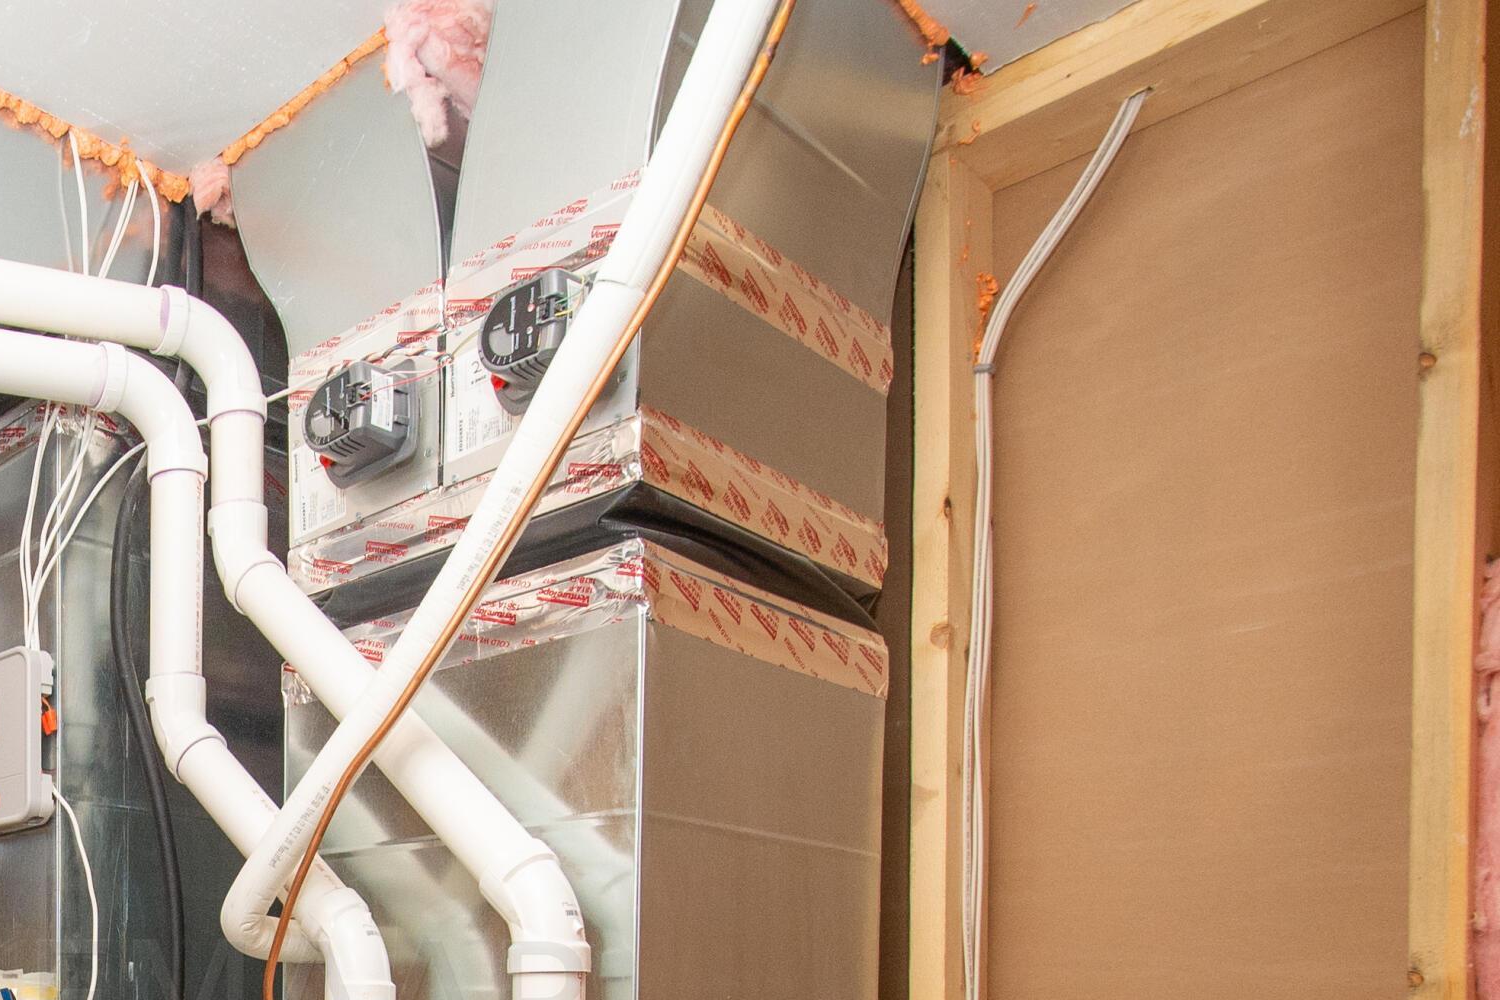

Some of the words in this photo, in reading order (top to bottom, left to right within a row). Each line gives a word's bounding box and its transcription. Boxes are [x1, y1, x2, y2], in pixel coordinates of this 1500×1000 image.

[567, 466, 622, 478] VentureTape
[365, 545, 407, 556] VentureTape
[536, 590, 589, 603] VentureTape
